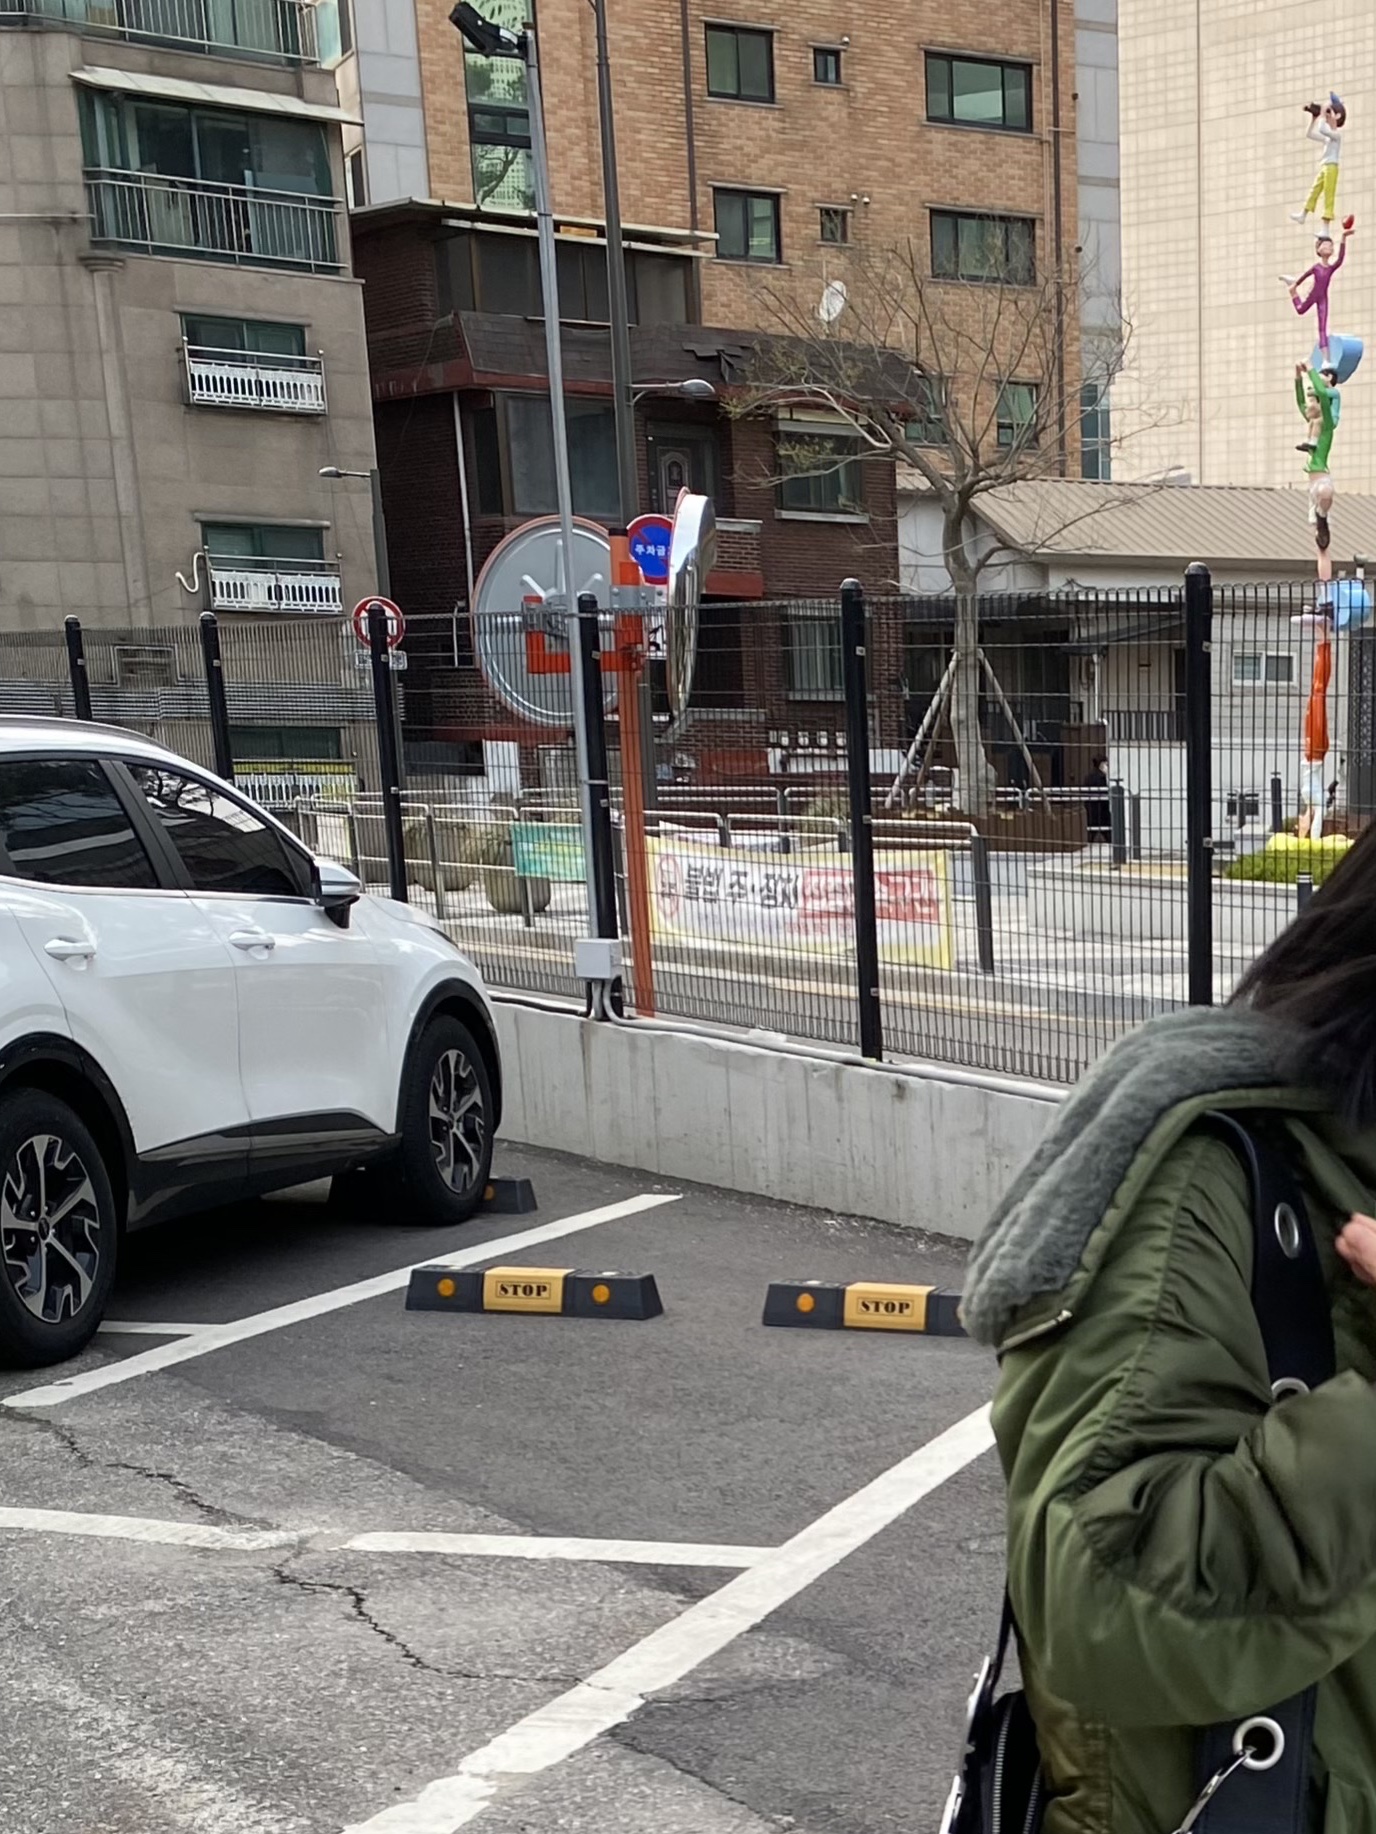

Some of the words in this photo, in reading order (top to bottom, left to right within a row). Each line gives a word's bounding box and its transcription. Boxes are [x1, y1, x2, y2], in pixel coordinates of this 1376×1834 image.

[634, 543, 670, 557] 주차금
[499, 1283, 548, 1297] STOP
[861, 1300, 910, 1314] STOP
